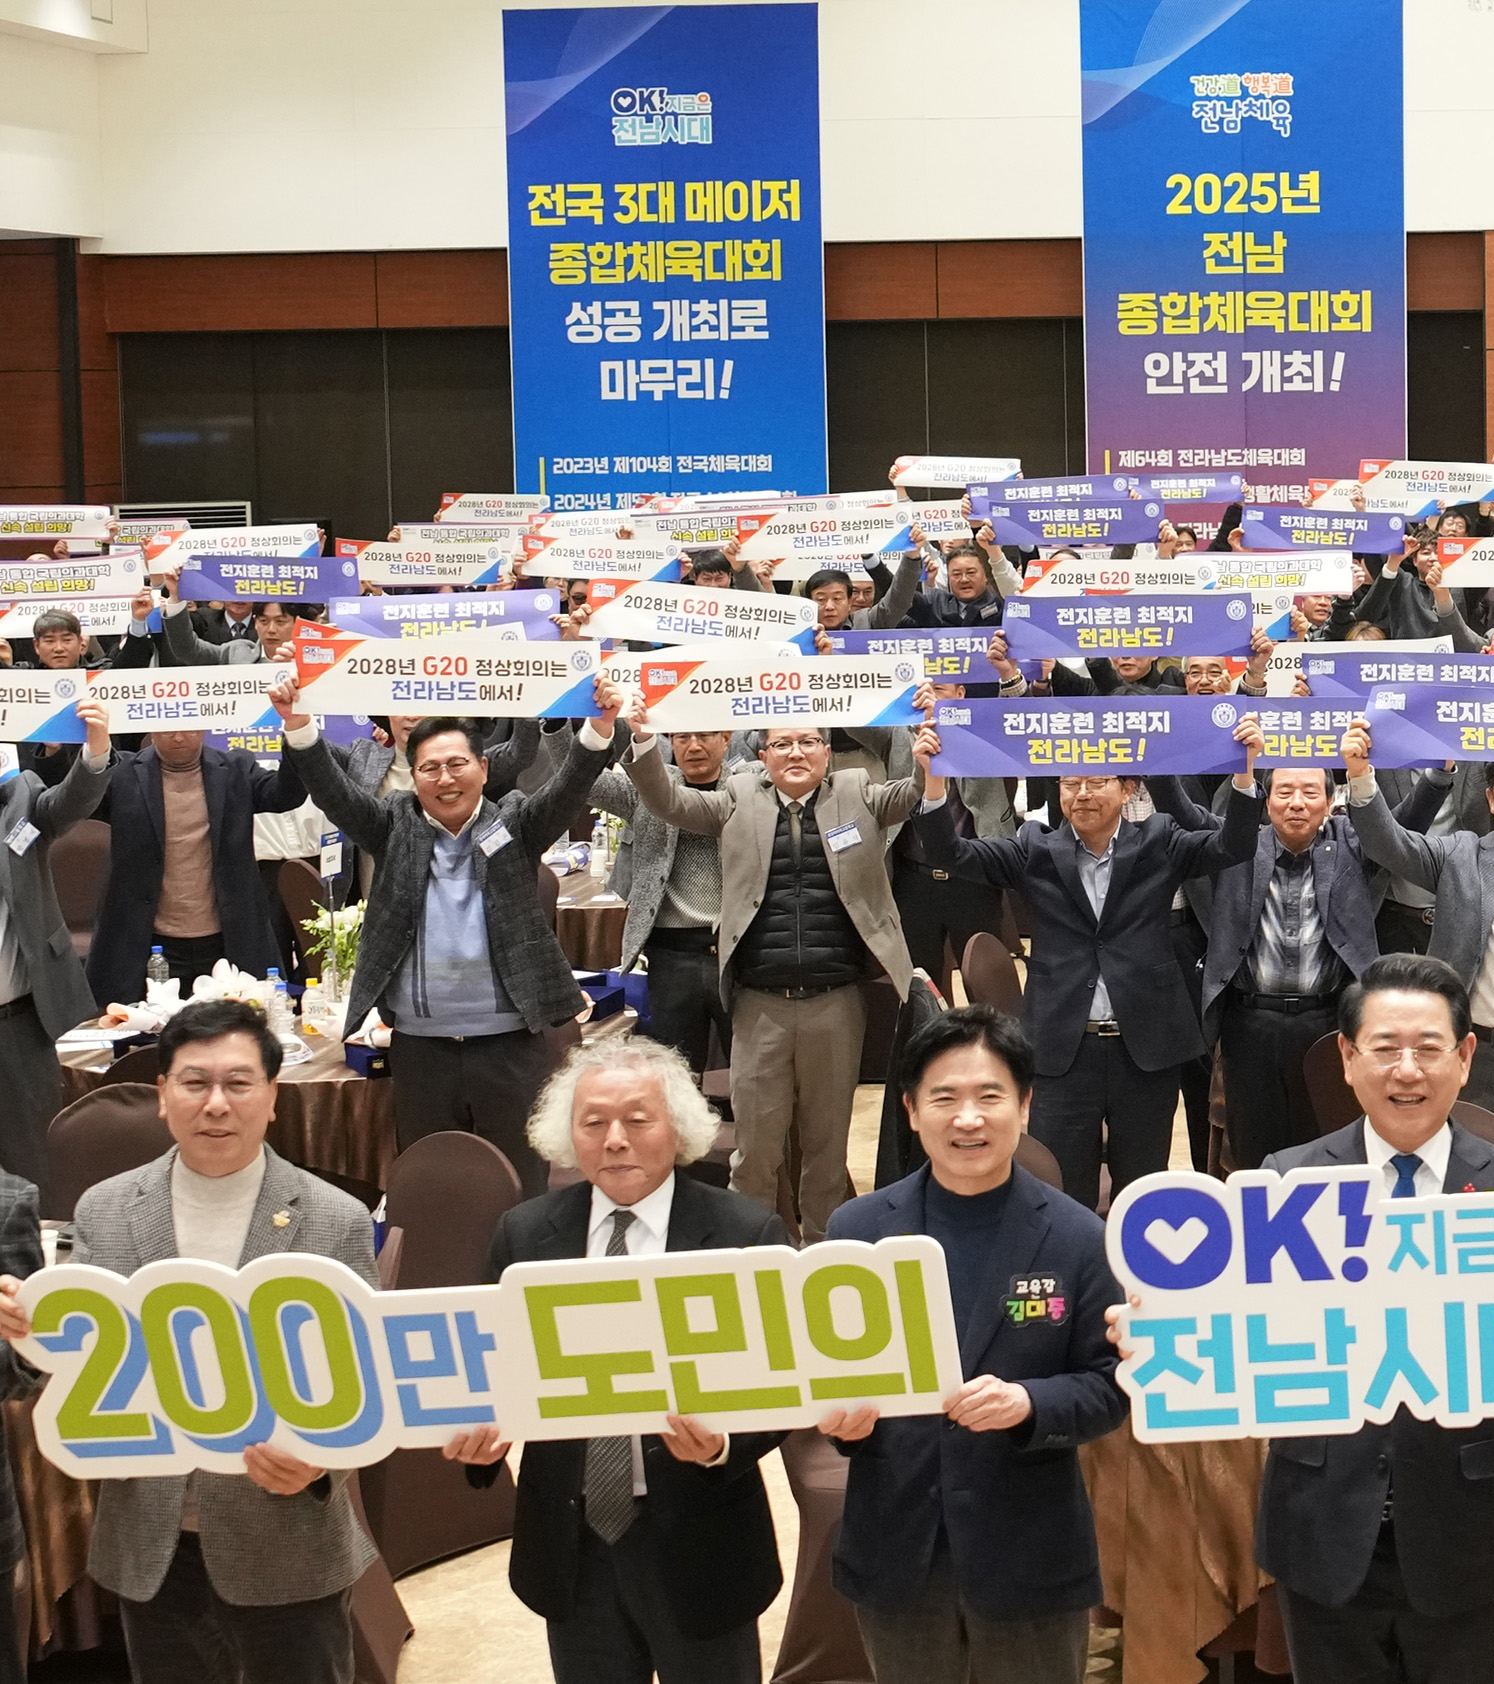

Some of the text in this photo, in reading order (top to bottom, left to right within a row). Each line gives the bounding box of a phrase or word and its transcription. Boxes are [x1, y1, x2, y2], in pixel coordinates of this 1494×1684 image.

[611, 88, 711, 114] OK! 지금은
[1193, 98, 1292, 137] 전남체육
[612, 115, 712, 145] 전남시대
[528, 180, 800, 226] 전국 3대 메이저
[1166, 170, 1320, 214] 2025년
[549, 239, 782, 285] 종합체육대회
[1203, 231, 1287, 274] 전남
[566, 299, 769, 343] 성공 개최로
[1117, 290, 1372, 335] 종합체육대회
[600, 359, 733, 401] 마무리!
[1144, 350, 1345, 394] 안전 개최!
[553, 455, 772, 474] 2023년 제104회 전국체육대회
[1119, 448, 1305, 467] 제64회 전라남도체육대회
[1385, 470, 1493, 484] 2028년 G20 정상회의는
[1406, 482, 1471, 493] 전라남도에서!
[554, 493, 611, 510] 2024년
[1027, 507, 1123, 522] 전지훈련 최적지
[1279, 515, 1368, 531] 전지훈련 최적지
[766, 518, 894, 536] 2028년 G20 정상회의는
[1041, 522, 1109, 538] 전라남도!
[1291, 530, 1355, 546] 전라남도!
[793, 533, 870, 549] 전라남도에서!
[219, 564, 318, 580] 전지훈련 최적지
[0, 578, 95, 594] 신속 설립 희망!
[234, 579, 304, 596] 전라남도!
[624, 595, 797, 626] 2028년 G20 정상회의는
[1056, 605, 1194, 626] 전지훈련 최적지
[656, 615, 760, 641] 전라남도에서!
[1076, 626, 1175, 649] 전라남도!
[346, 656, 568, 678] 2028년 G20 정상회의는
[89, 679, 271, 701] 2028년 G20 정상회의는
[391, 681, 523, 702] 전라남도에서!
[690, 672, 893, 695] 2028년 G20 정상회의는
[126, 700, 236, 720] 전라남도에서!
[730, 693, 852, 718] 전라남도에서!
[1003, 710, 1171, 736] 전지훈련 최적지
[1027, 738, 1146, 764] 전라남도!
[1121, 1180, 1374, 1290] OK!
[523, 1260, 940, 1418] 도민의
